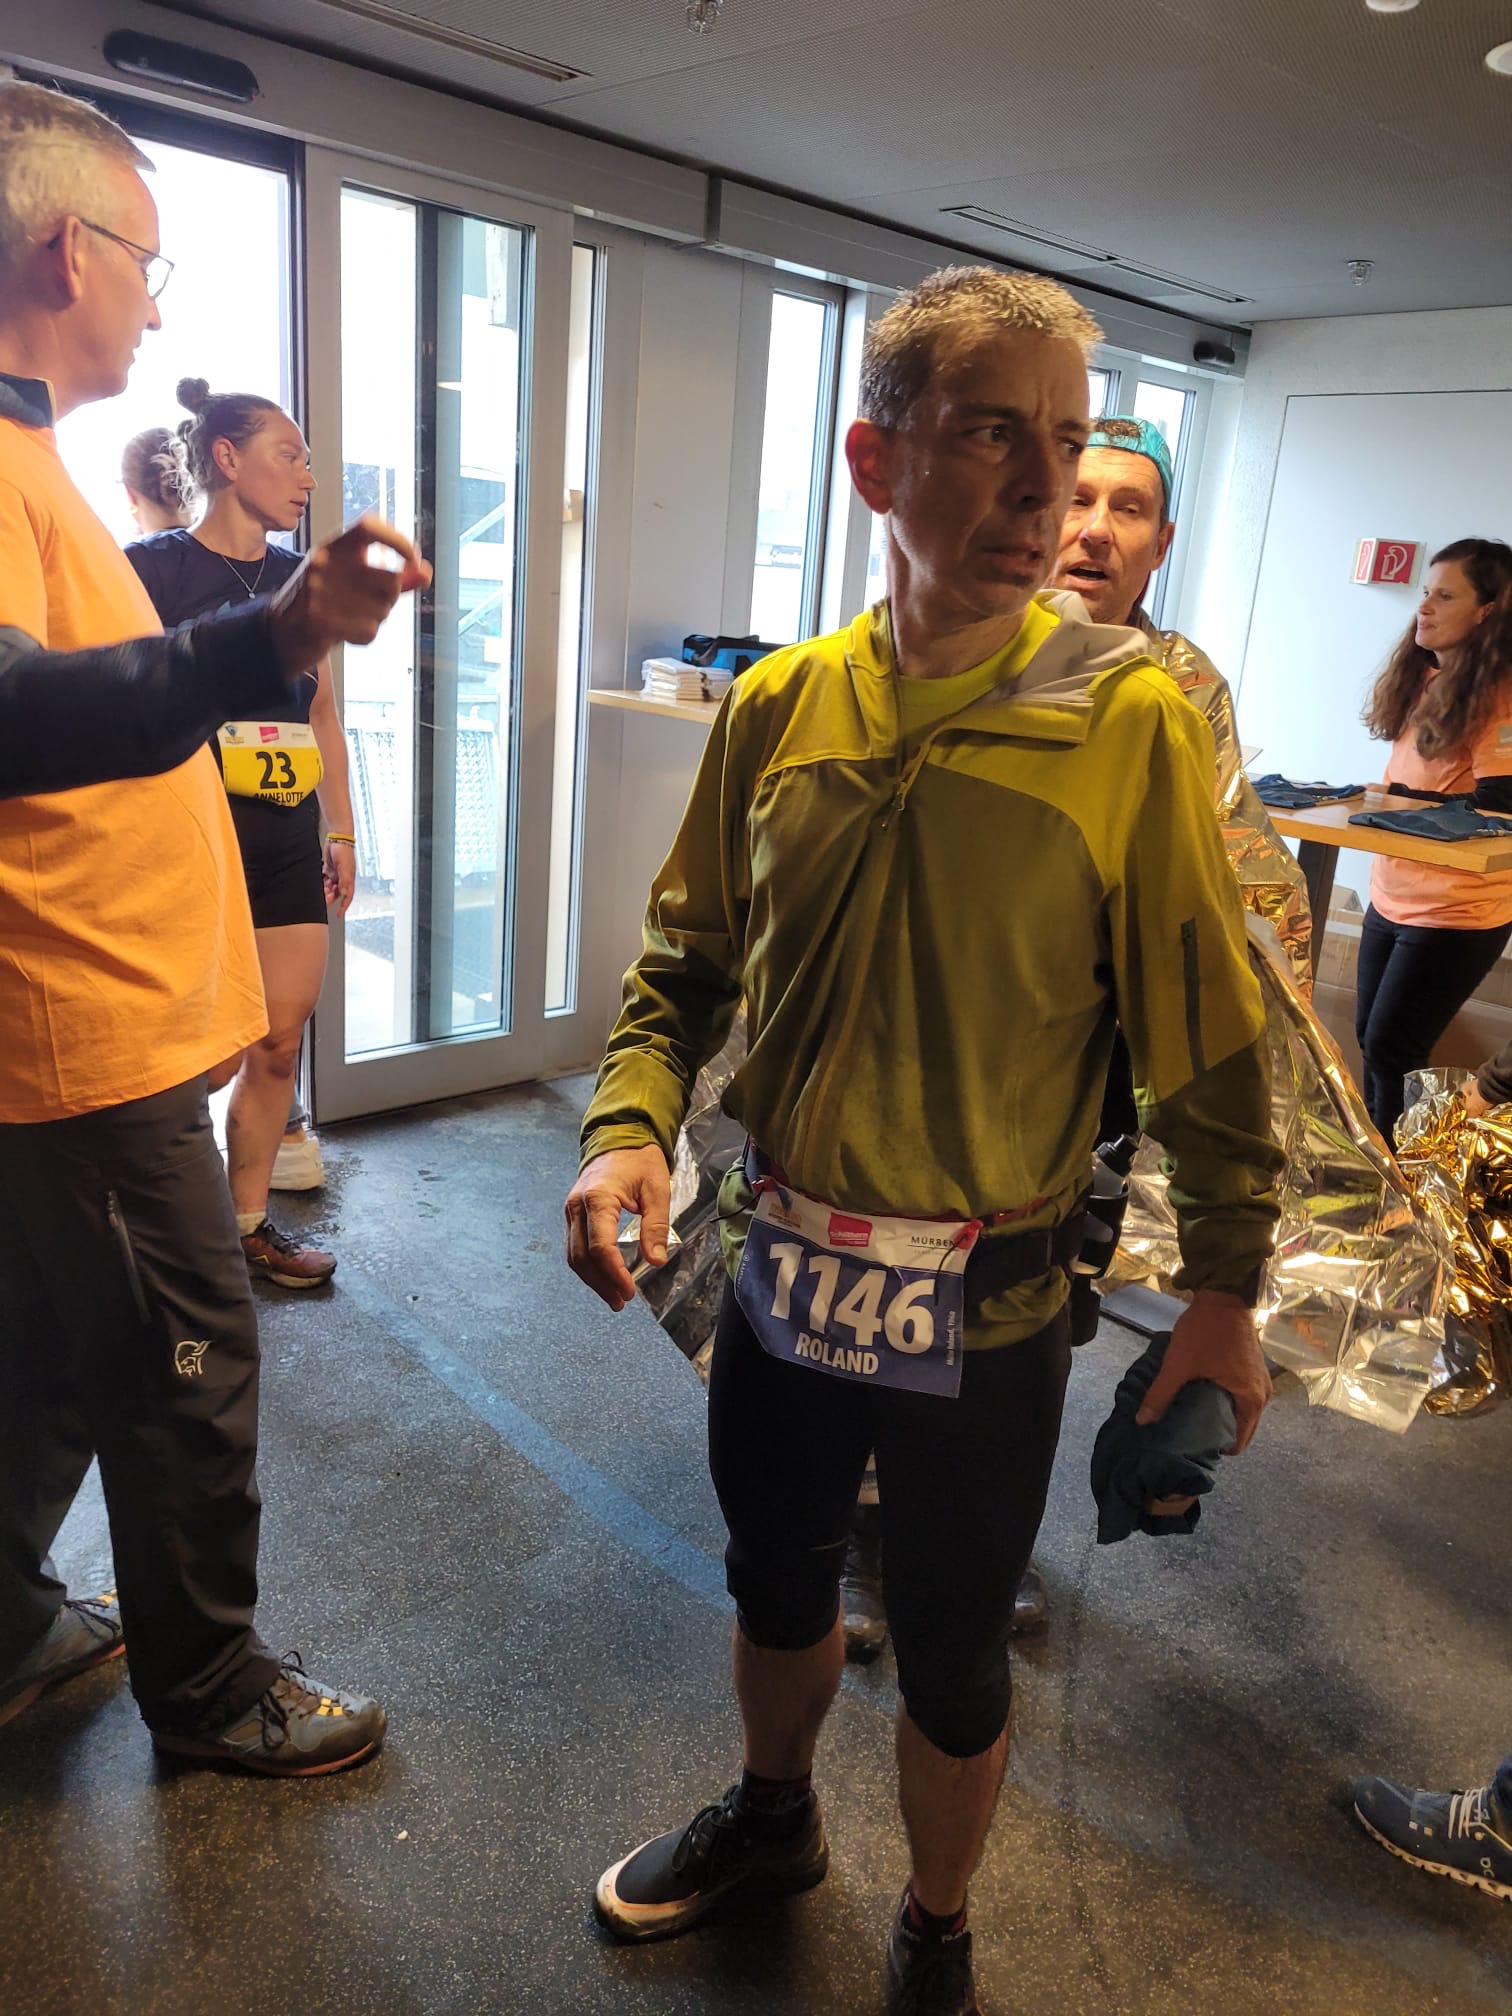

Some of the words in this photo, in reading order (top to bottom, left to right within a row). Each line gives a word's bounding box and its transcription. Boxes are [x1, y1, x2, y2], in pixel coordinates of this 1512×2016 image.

[255, 751, 297, 790] 23
[769, 1242, 935, 1354] 1146
[796, 1332, 879, 1375] ROLAND
